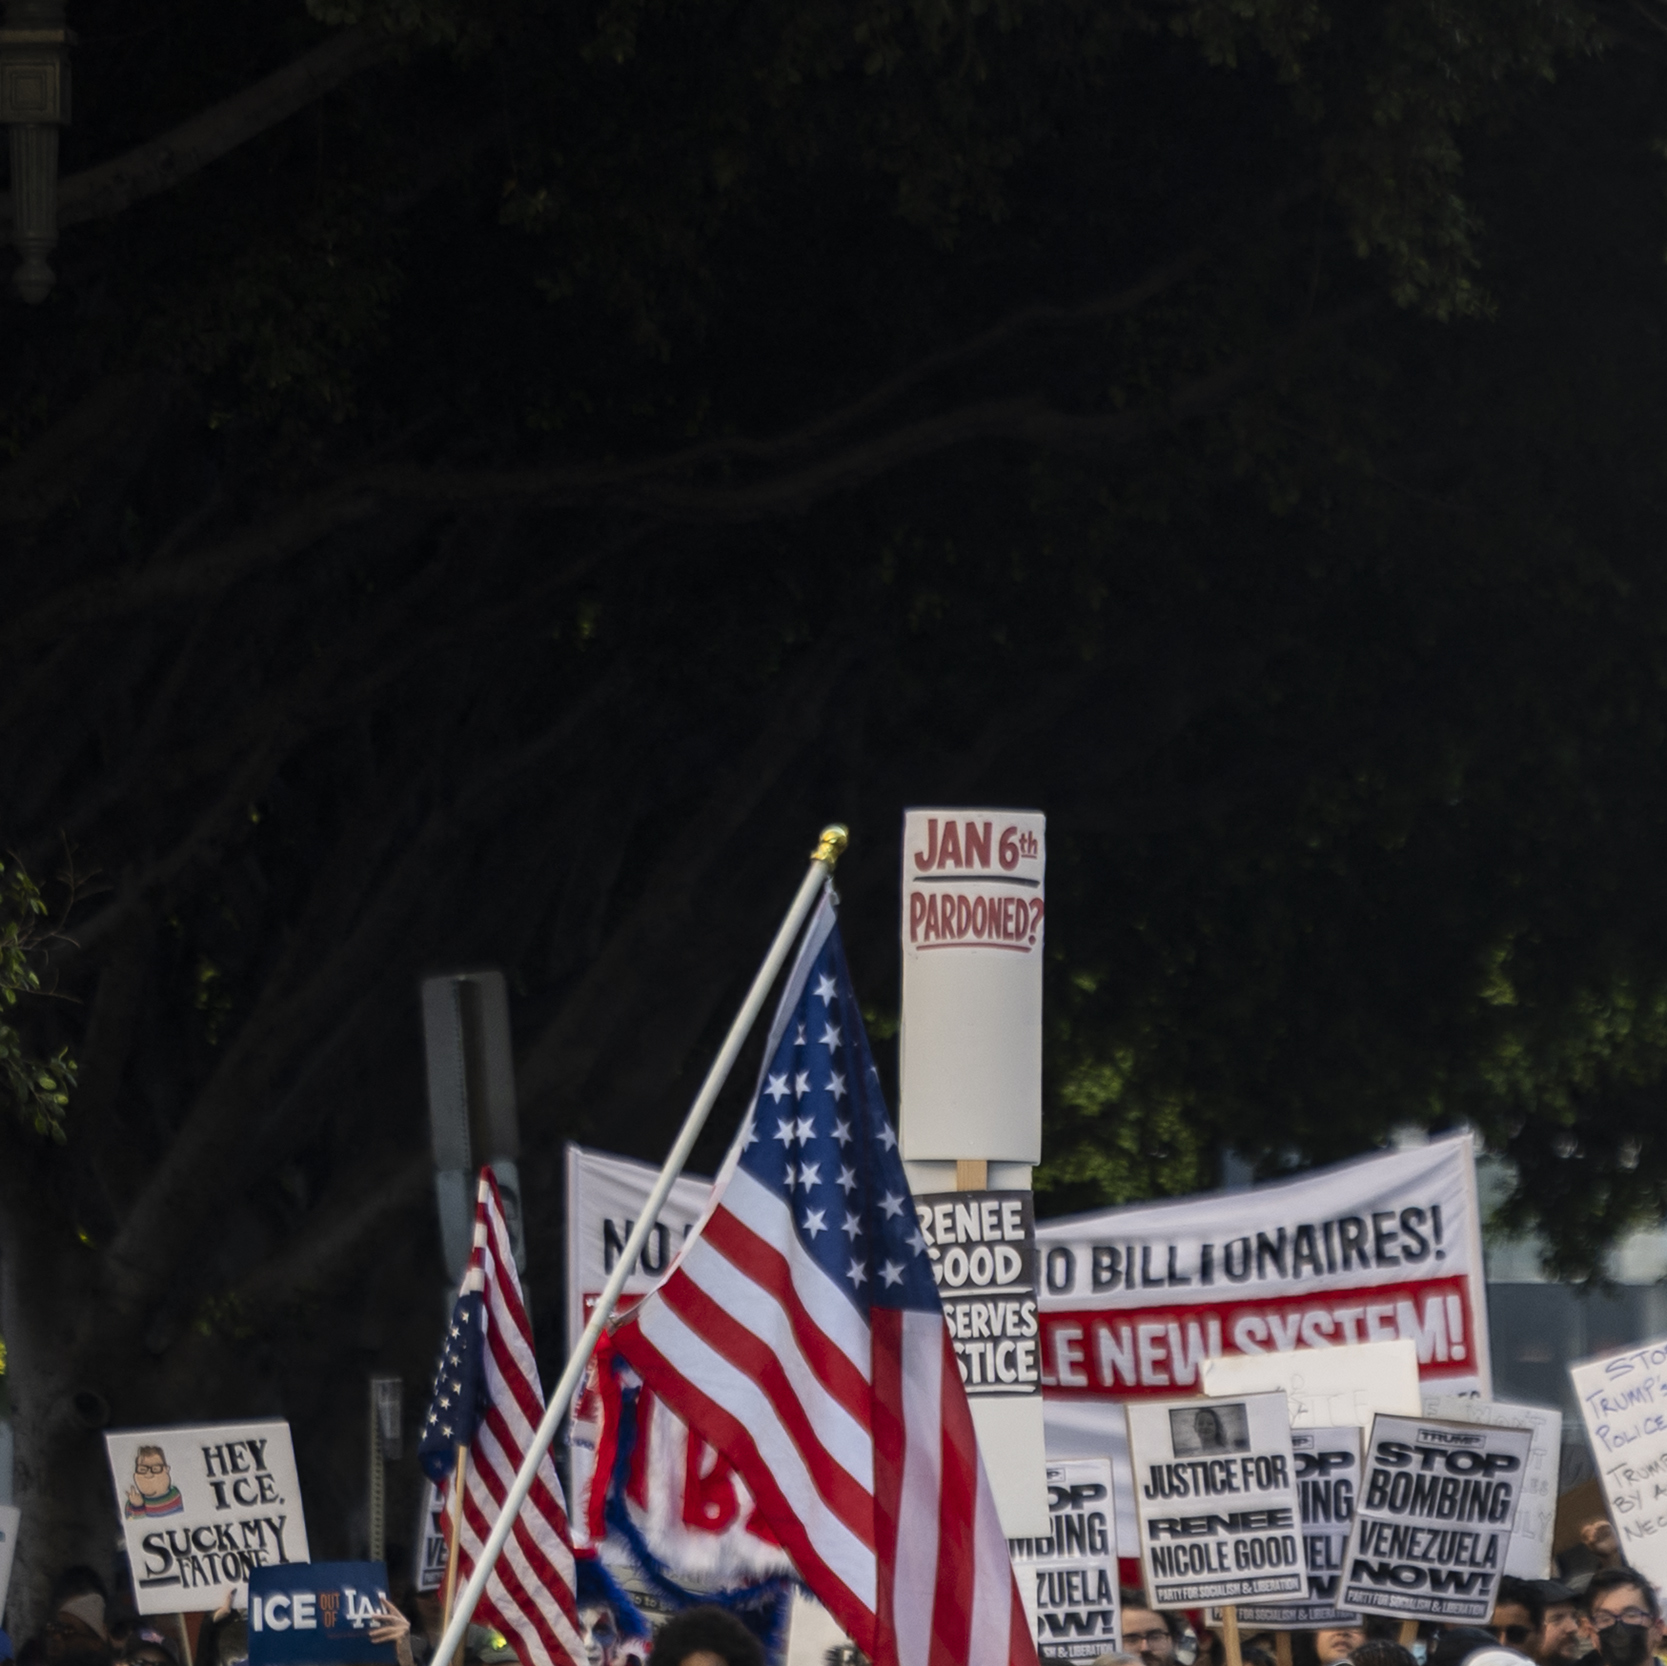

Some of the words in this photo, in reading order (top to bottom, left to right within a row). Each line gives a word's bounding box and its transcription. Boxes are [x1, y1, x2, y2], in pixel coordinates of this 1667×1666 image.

[914, 819, 992, 872] JAN
[998, 826, 1038, 872] 6th
[909, 891, 1044, 946] PARDONED?
[915, 1200, 1026, 1246] RENEE
[927, 1246, 1022, 1287] GOOD
[1090, 1205, 1446, 1294] BILLIONAIRES!
[943, 1301, 1038, 1339] SERVES
[955, 1340, 1038, 1384] STICE
[1097, 1317, 1223, 1388] NEW
[202, 1438, 268, 1478] HEY
[1420, 1431, 1482, 1445] TRUMP
[1144, 1459, 1240, 1501] JUSTICE
[1241, 1454, 1291, 1493] FOR
[1374, 1441, 1521, 1478] STOP
[1365, 1469, 1513, 1524] BOMBING
[1612, 1490, 1643, 1515] BY
[1148, 1507, 1294, 1541] RENEE
[1360, 1519, 1499, 1569] VENEZUELA
[141, 1521, 241, 1578] SUCK
[239, 1515, 290, 1564] MY
[1151, 1540, 1233, 1579] NICOLE
[1234, 1535, 1298, 1572] GOOD
[1037, 1569, 1113, 1609] ZUELA
[1158, 1587, 1182, 1602] PARTY
[1184, 1586, 1199, 1599] FOR
[1199, 1583, 1240, 1599] SOCIALISM
[1243, 1582, 1252, 1594] &
[1253, 1577, 1298, 1593] LIBERATION
[1350, 1559, 1496, 1597] NOW!
[253, 1593, 318, 1632] ICE
[319, 1593, 340, 1611] OUT
[323, 1611, 338, 1628] OF
[1347, 1591, 1371, 1605] PARTY
[1373, 1593, 1388, 1607] FOR
[1432, 1601, 1441, 1613] &
[1442, 1602, 1485, 1616] LIBERATION
